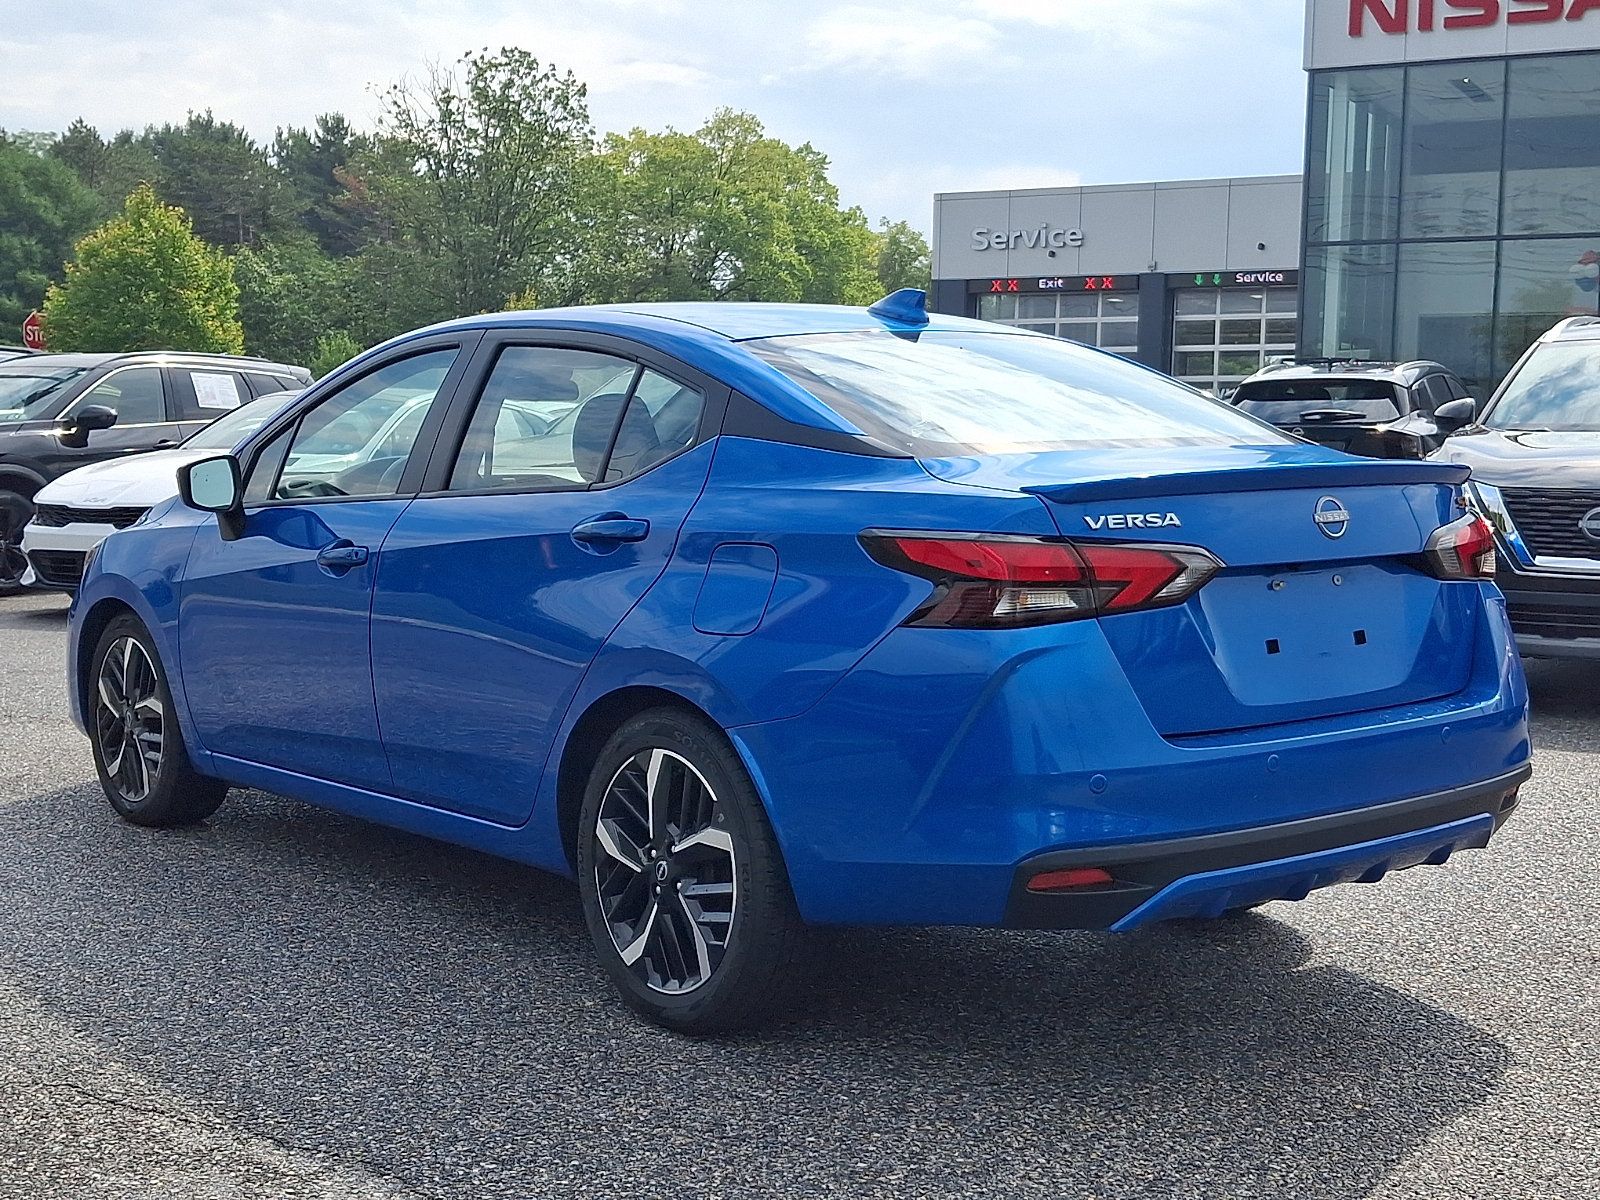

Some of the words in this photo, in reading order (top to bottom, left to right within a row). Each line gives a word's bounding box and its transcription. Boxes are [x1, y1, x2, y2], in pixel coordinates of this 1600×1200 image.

[971, 222, 1083, 251] Service
[1038, 277, 1064, 289] Exit
[1235, 271, 1284, 283] Service
[25, 325, 45, 342] ST
[1083, 512, 1182, 530] VERSA
[1315, 511, 1350, 523] NISSAN
